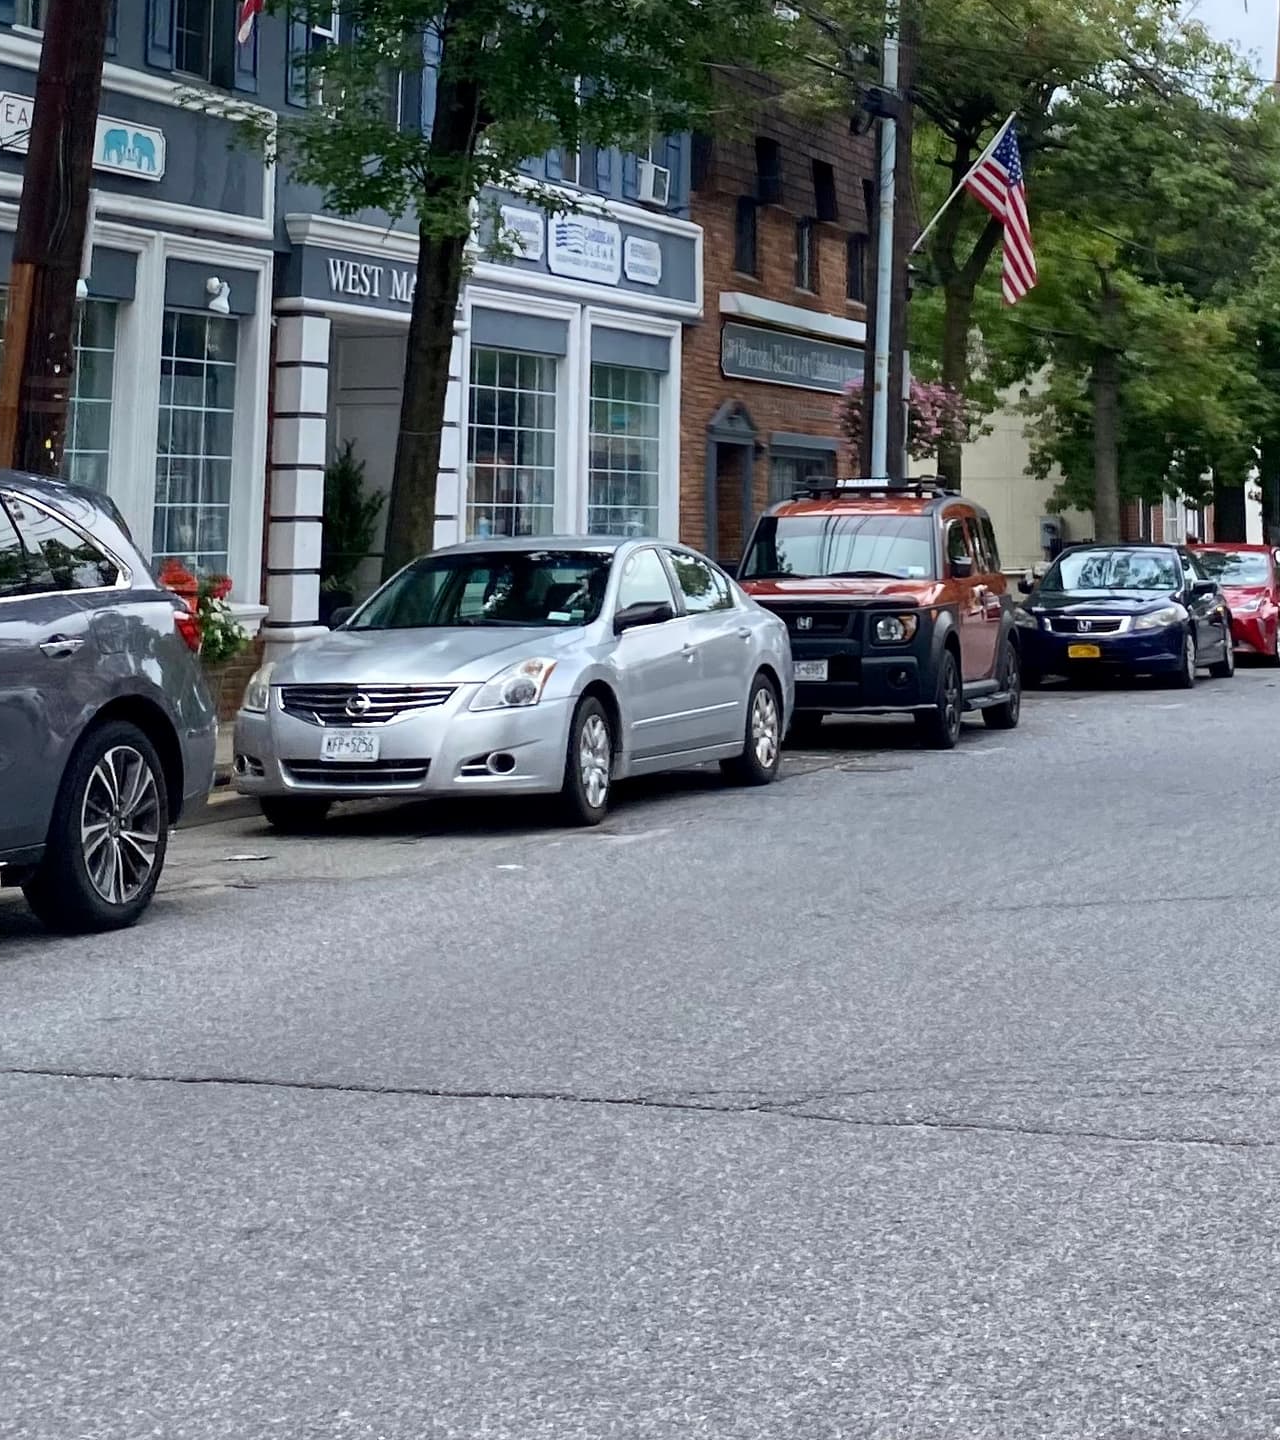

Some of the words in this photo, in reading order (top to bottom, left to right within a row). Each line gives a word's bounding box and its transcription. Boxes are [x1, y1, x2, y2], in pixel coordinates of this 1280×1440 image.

[5, 103, 29, 127] EA
[328, 258, 383, 298] WEST
[389, 269, 418, 303] MA
